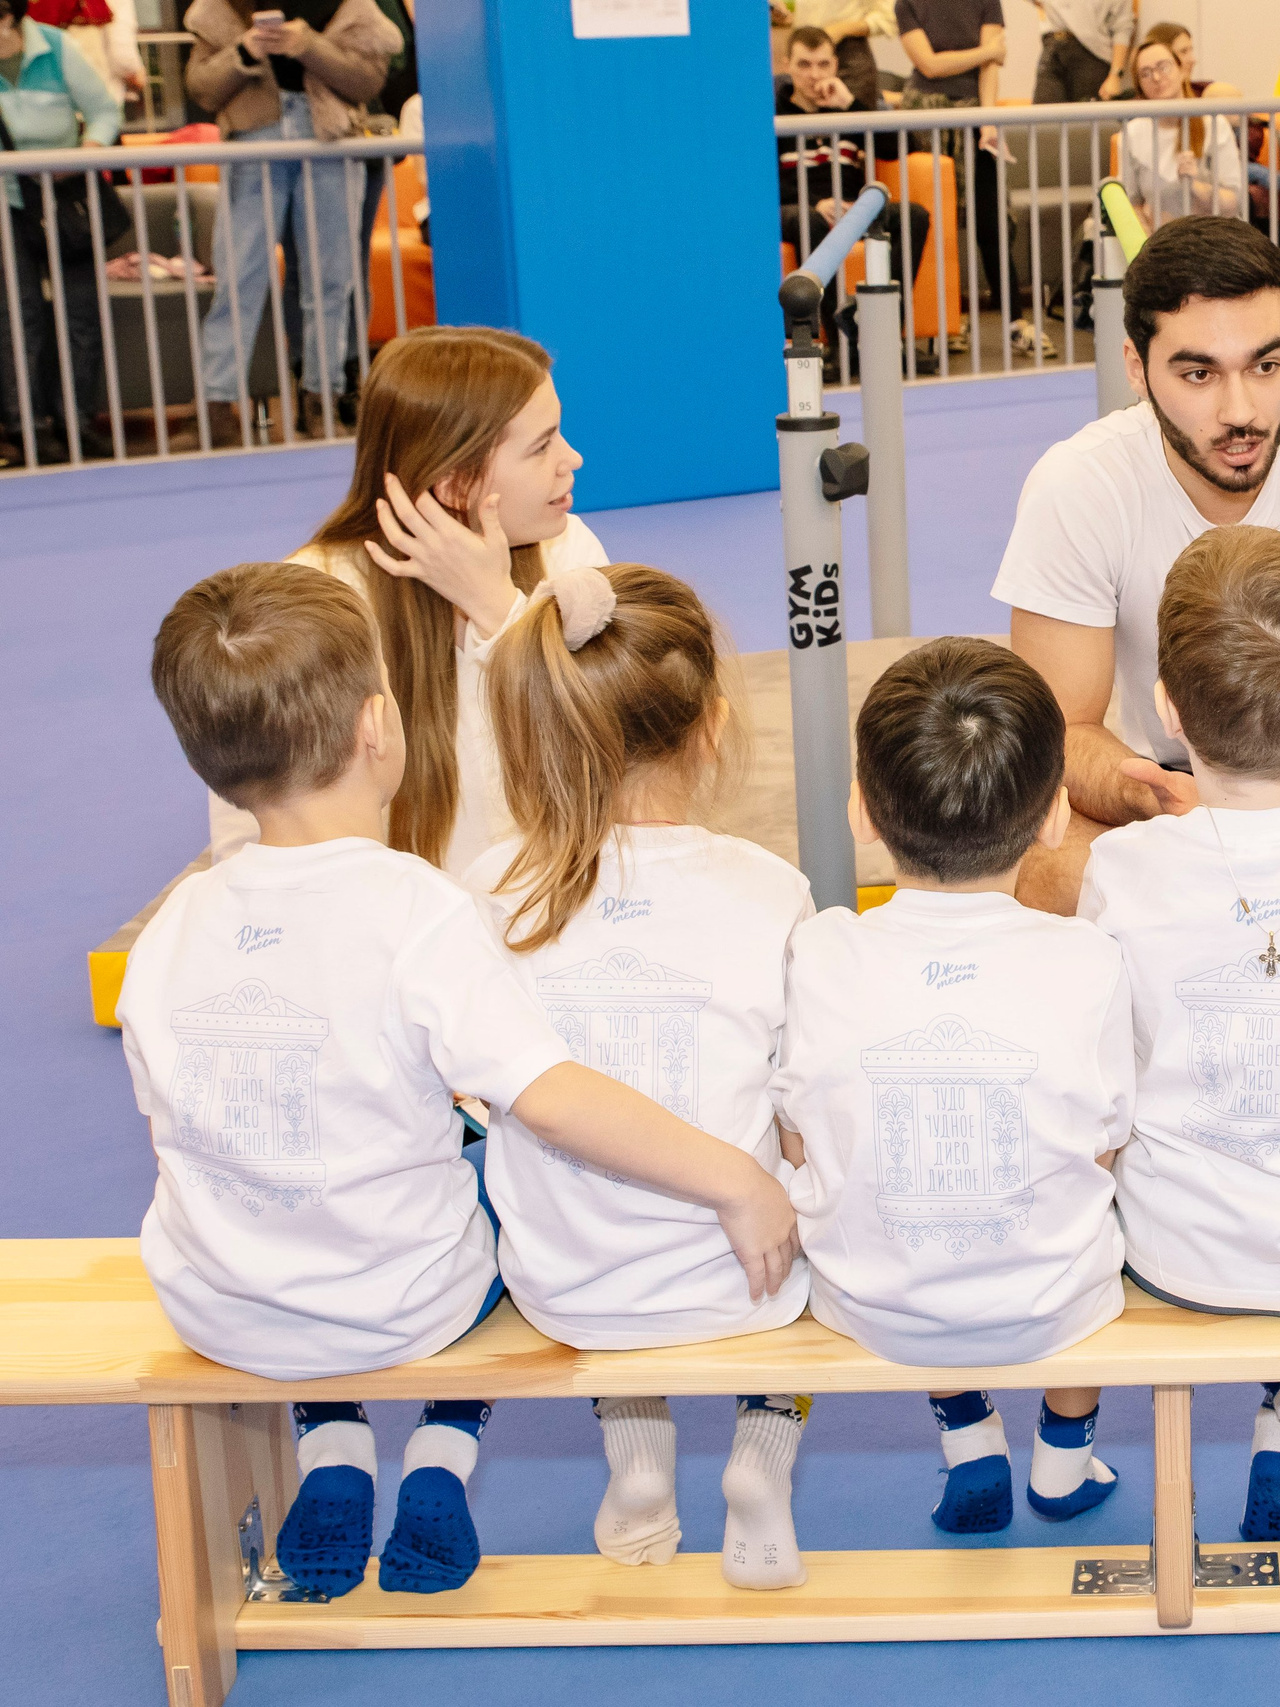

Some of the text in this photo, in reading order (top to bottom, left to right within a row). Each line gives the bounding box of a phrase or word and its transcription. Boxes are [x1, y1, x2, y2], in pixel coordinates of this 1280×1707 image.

[796, 359, 810, 369] 90
[798, 401, 812, 412] 95
[788, 564, 814, 650] GYM
[605, 1014, 639, 1039] ЧУДО
[1244, 1016, 1274, 1041] ЧУДО
[229, 1050, 258, 1075] ЧУДО
[596, 1042, 647, 1067] ЧУДНОЕ
[1233, 1042, 1280, 1067] ЧУДНОЕ
[220, 1077, 265, 1103] ЧУДНОЕ
[932, 1086, 966, 1112] ЧУДО
[924, 1114, 975, 1139] ЧУДНОЕ
